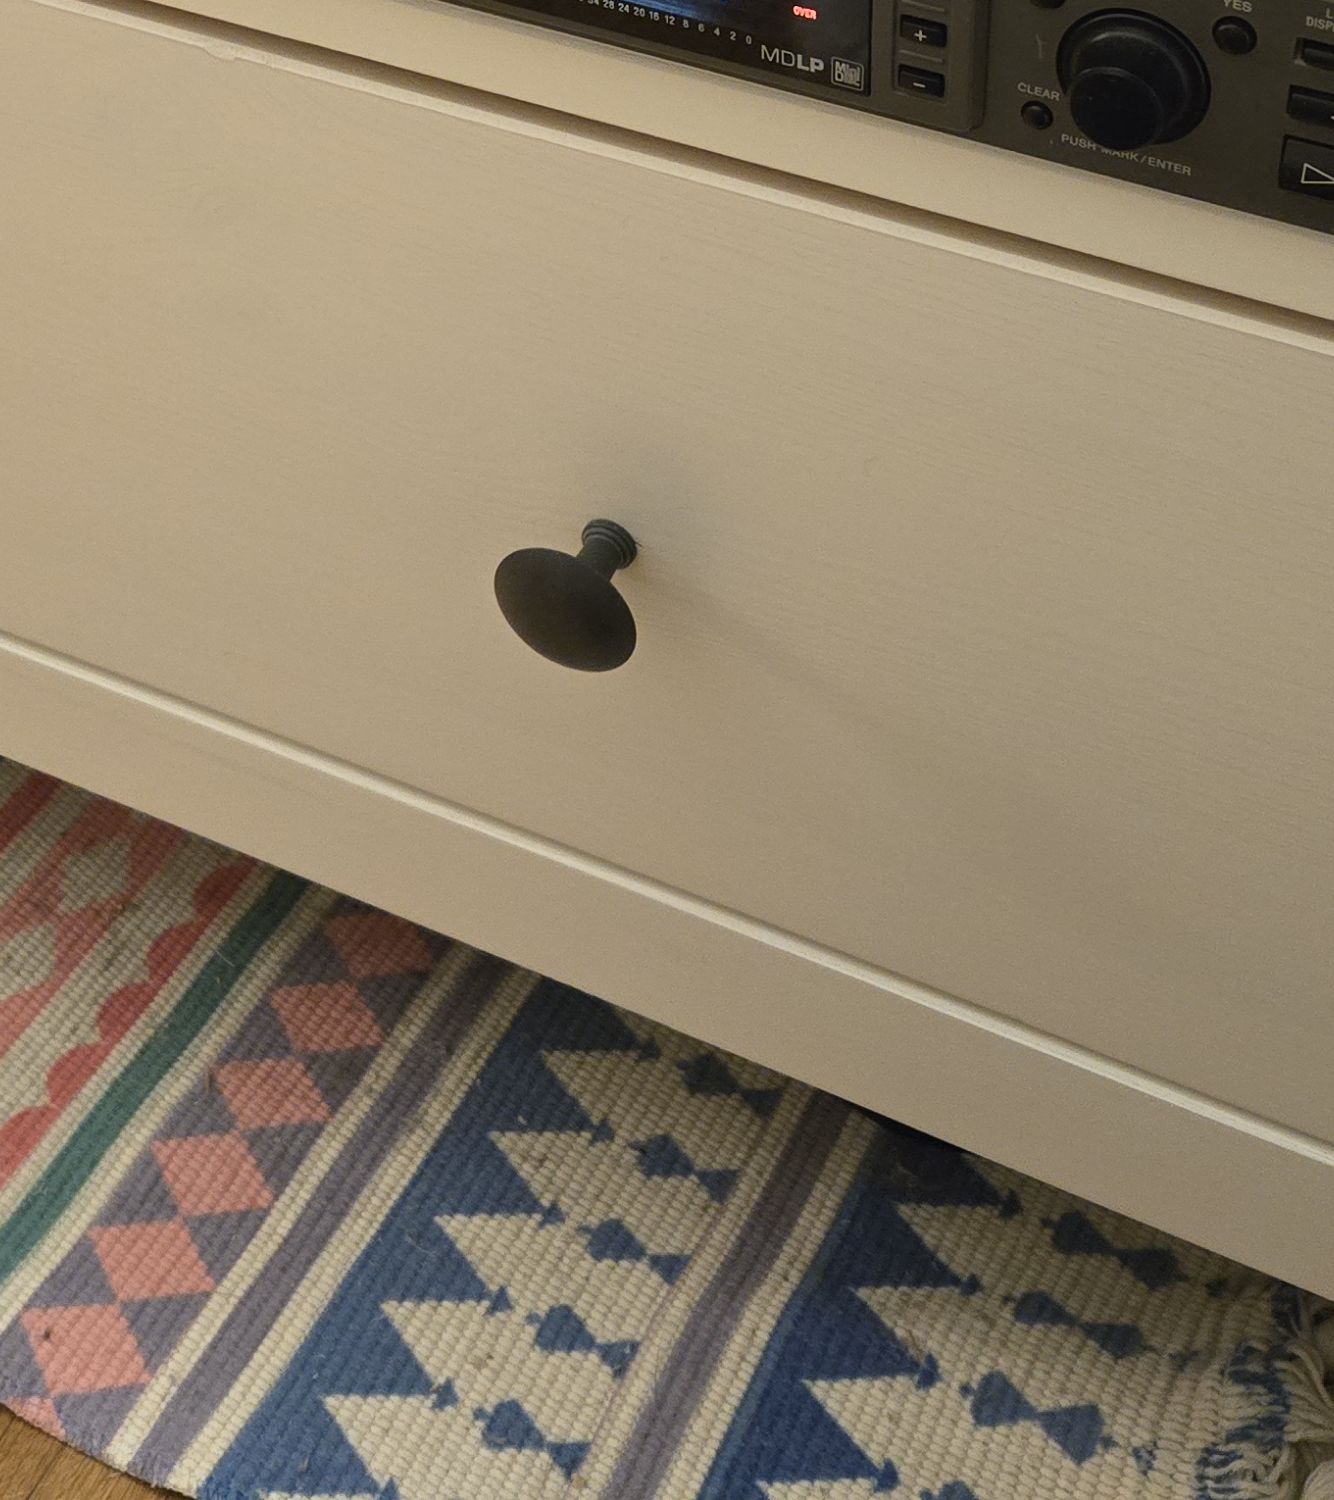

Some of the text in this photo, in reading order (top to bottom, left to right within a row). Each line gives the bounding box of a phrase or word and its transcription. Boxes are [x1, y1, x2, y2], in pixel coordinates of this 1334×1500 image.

[793, 5, 817, 20] OVER
[618, 2, 630, 14] 24
[633, 6, 646, 18] 20
[649, 10, 660, 22] 16
[664, 14, 676, 26] 12
[682, 18, 690, 29] 8
[697, 22, 705, 33] 6
[713, 26, 721, 37] 4
[729, 30, 737, 42] 2
[745, 34, 753, 45] 0
[760, 44, 825, 73] MDLP
[1017, 81, 1061, 102] CLEAR
[1060, 133, 1097, 152] PUSH
